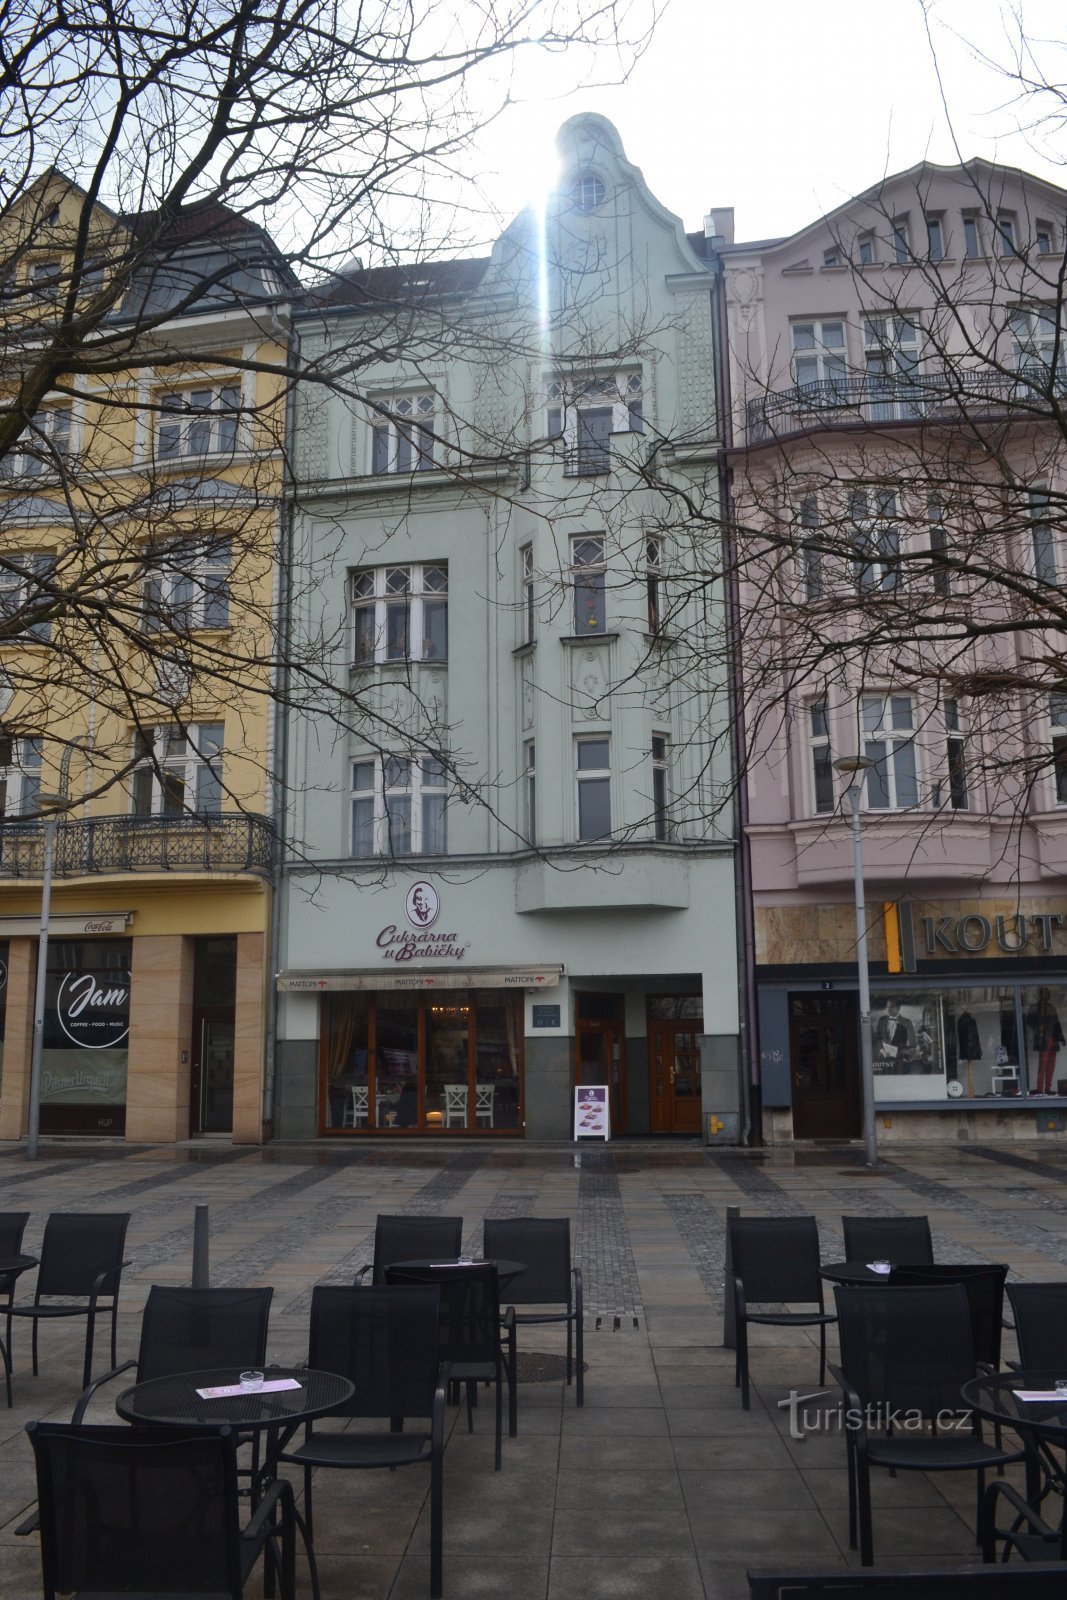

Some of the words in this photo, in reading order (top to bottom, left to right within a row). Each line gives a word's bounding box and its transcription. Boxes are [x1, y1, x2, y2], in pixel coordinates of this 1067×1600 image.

[84, 920, 114, 933] Coca-Cola
[922, 914, 1067, 952] KOUT
[376, 925, 458, 948] Cukrárna
[383, 949, 395, 959] u
[394, 943, 466, 962] Babičky
[289, 980, 317, 988] MATTONI
[395, 978, 424, 986] MATTONI
[504, 976, 534, 984] MATTONI
[68, 974, 128, 1018] Jam
[98, 1118, 113, 1127] HUP
